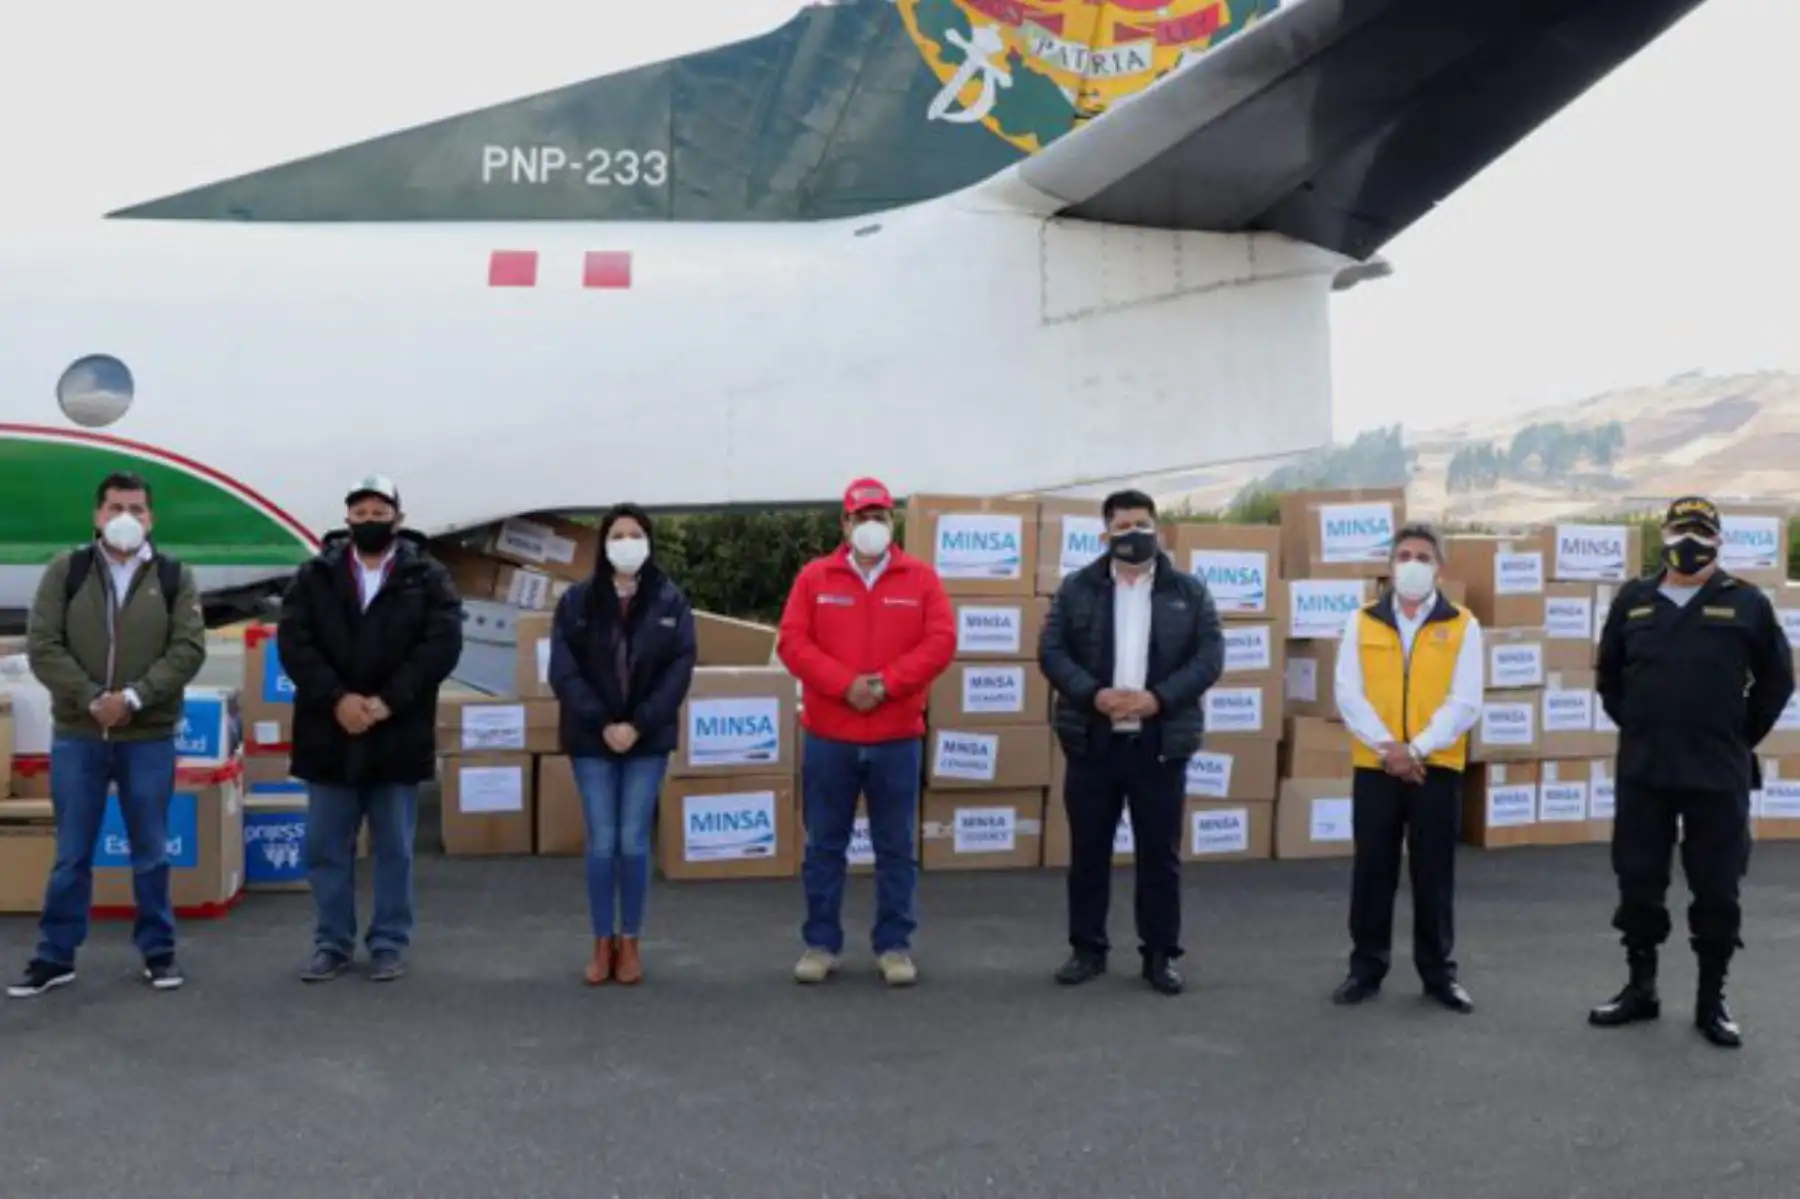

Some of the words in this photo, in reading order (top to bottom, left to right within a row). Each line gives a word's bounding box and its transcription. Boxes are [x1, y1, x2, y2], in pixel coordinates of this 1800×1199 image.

[1037, 36, 1146, 75] PATRIA
[481, 144, 668, 186] PNP-233
[1326, 516, 1389, 537] MINSA
[942, 530, 1016, 551] MINSA
[1561, 537, 1621, 556] MINSA
[1196, 565, 1262, 586] MINSA
[1297, 593, 1359, 612] MINSA
[695, 714, 775, 737] MINSA
[690, 809, 771, 834] MINSA
